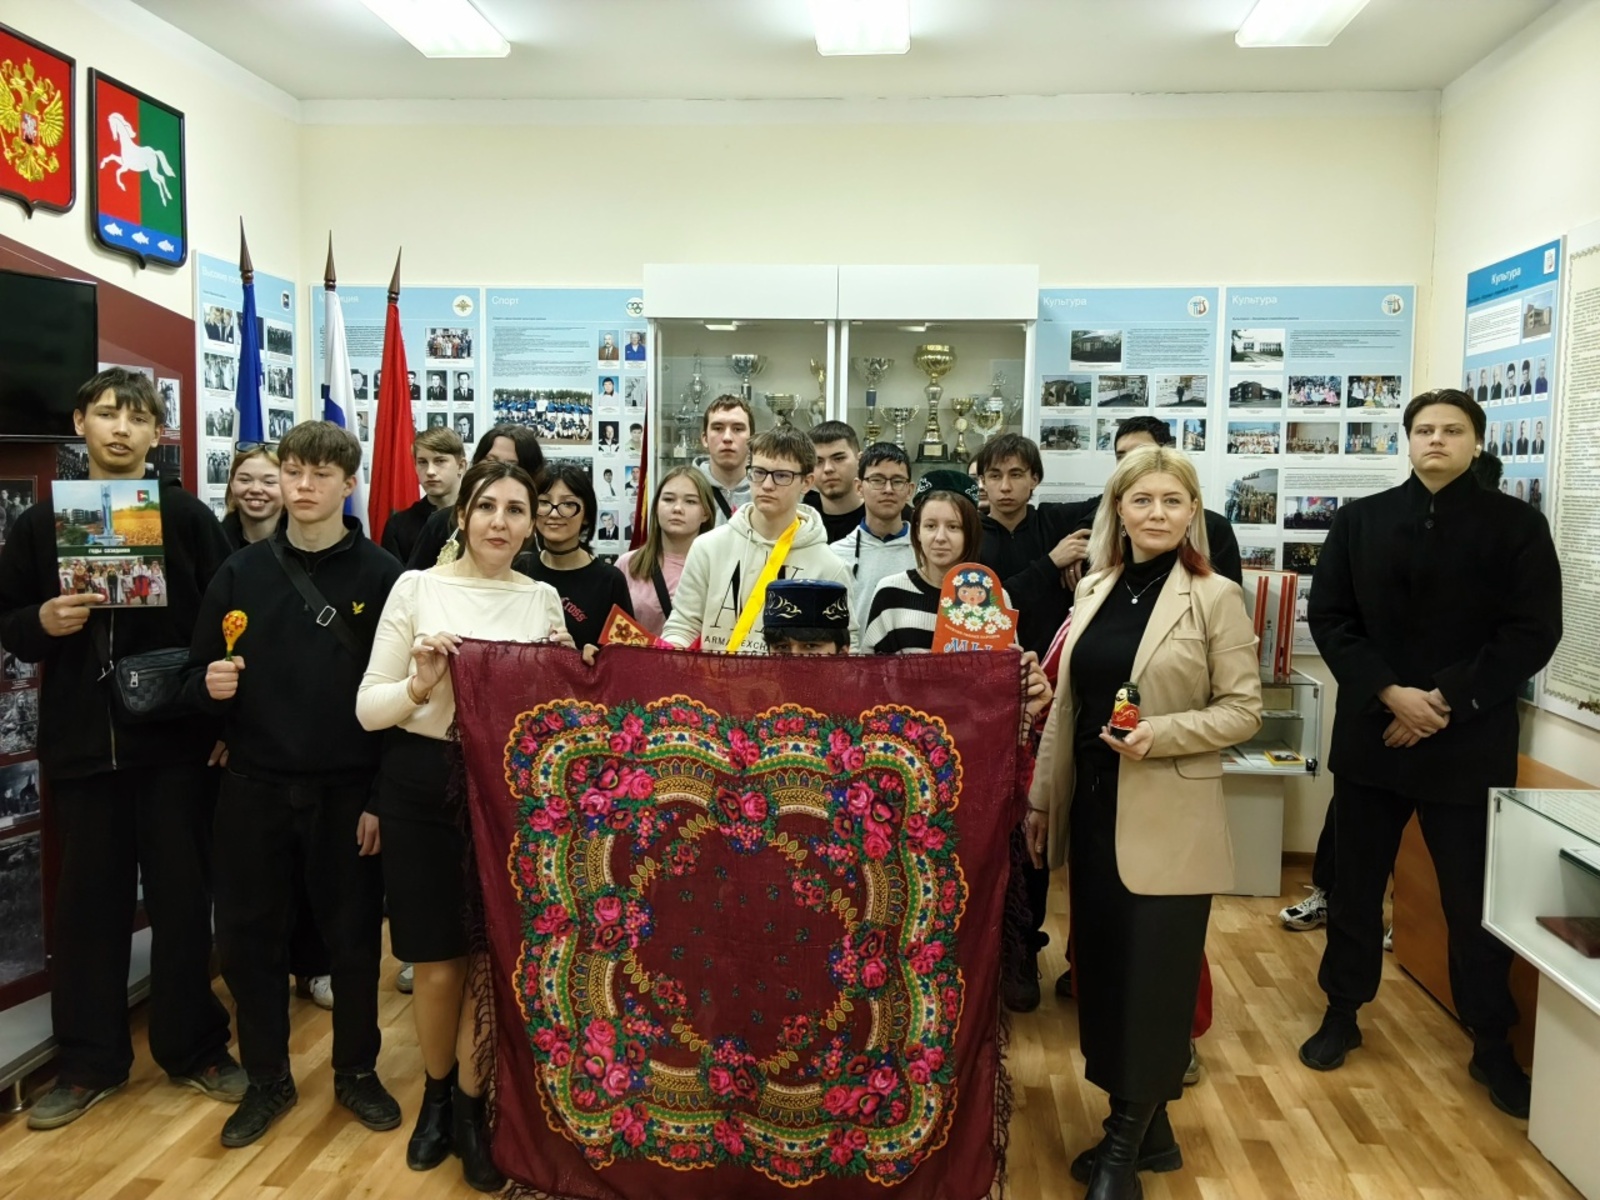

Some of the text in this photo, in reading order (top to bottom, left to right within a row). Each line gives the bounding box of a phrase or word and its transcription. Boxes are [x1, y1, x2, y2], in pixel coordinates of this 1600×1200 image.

[1492, 267, 1521, 285] Культура
[492, 295, 519, 307] Спорт
[1043, 296, 1087, 309] Культура
[1232, 294, 1277, 307] Культура
